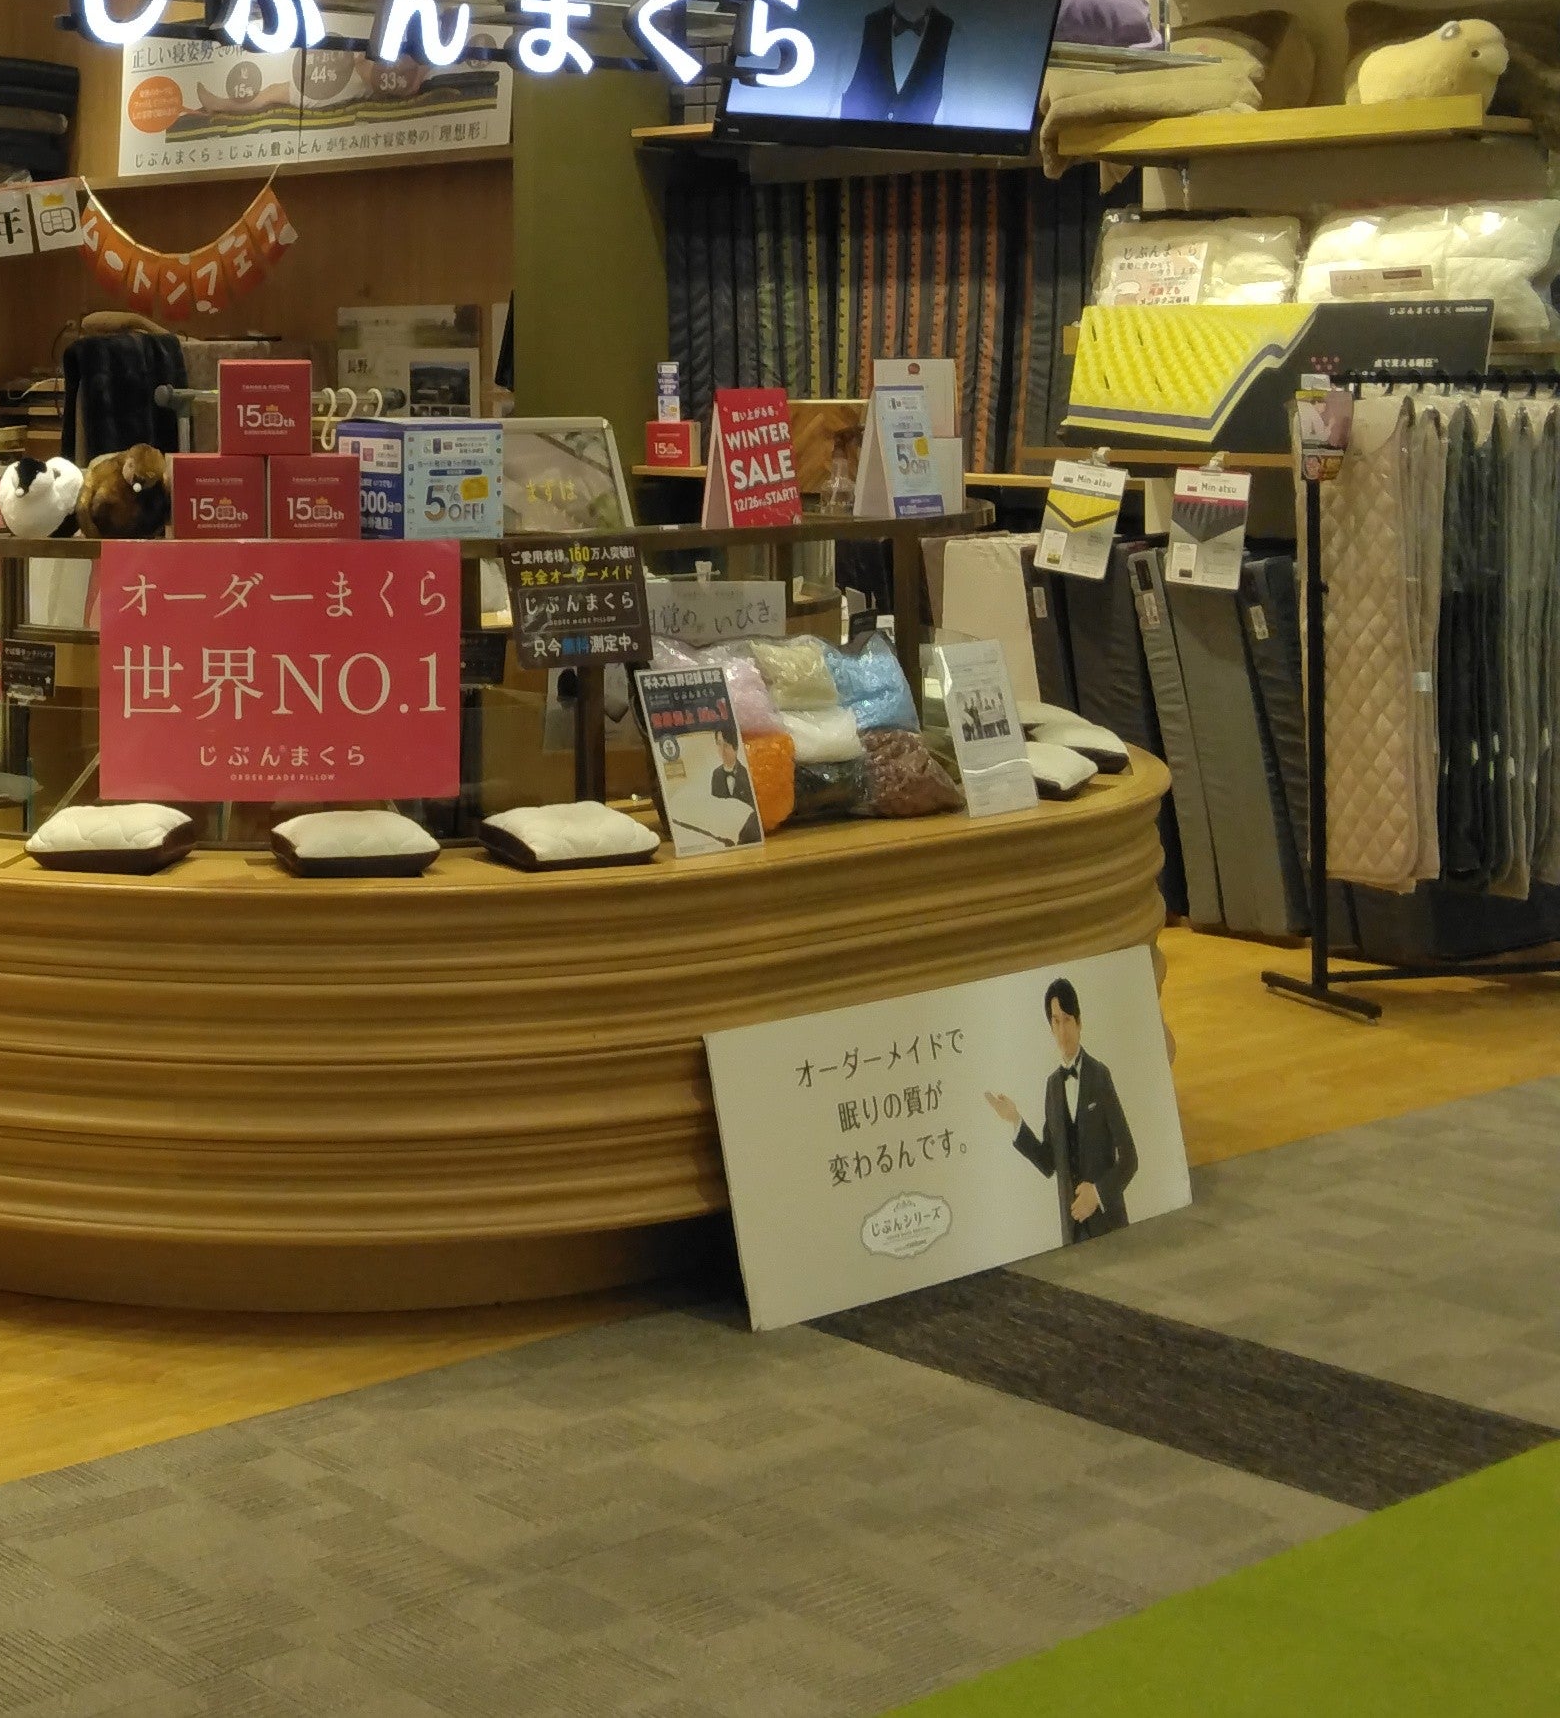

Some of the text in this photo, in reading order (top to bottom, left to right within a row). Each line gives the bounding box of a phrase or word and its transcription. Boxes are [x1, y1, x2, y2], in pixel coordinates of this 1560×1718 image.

[310, 66, 338, 84] 44%
[378, 71, 408, 91] 33%
[724, 421, 791, 453] WINTER
[729, 448, 797, 490] SALE
[448, 502, 486, 522] OFF!
[520, 565, 634, 587] 完全オーダーメイド
[118, 569, 447, 619] オーダーまくら
[525, 591, 635, 615] じぶんまくら
[112, 644, 447, 721] 世界NO.1
[795, 1027, 965, 1088] オーダーメイドで
[838, 1080, 943, 1134] 眠りの質が
[827, 1128, 969, 1187] 変わるんです。
[871, 1205, 942, 1238] じぶんシリーズ
